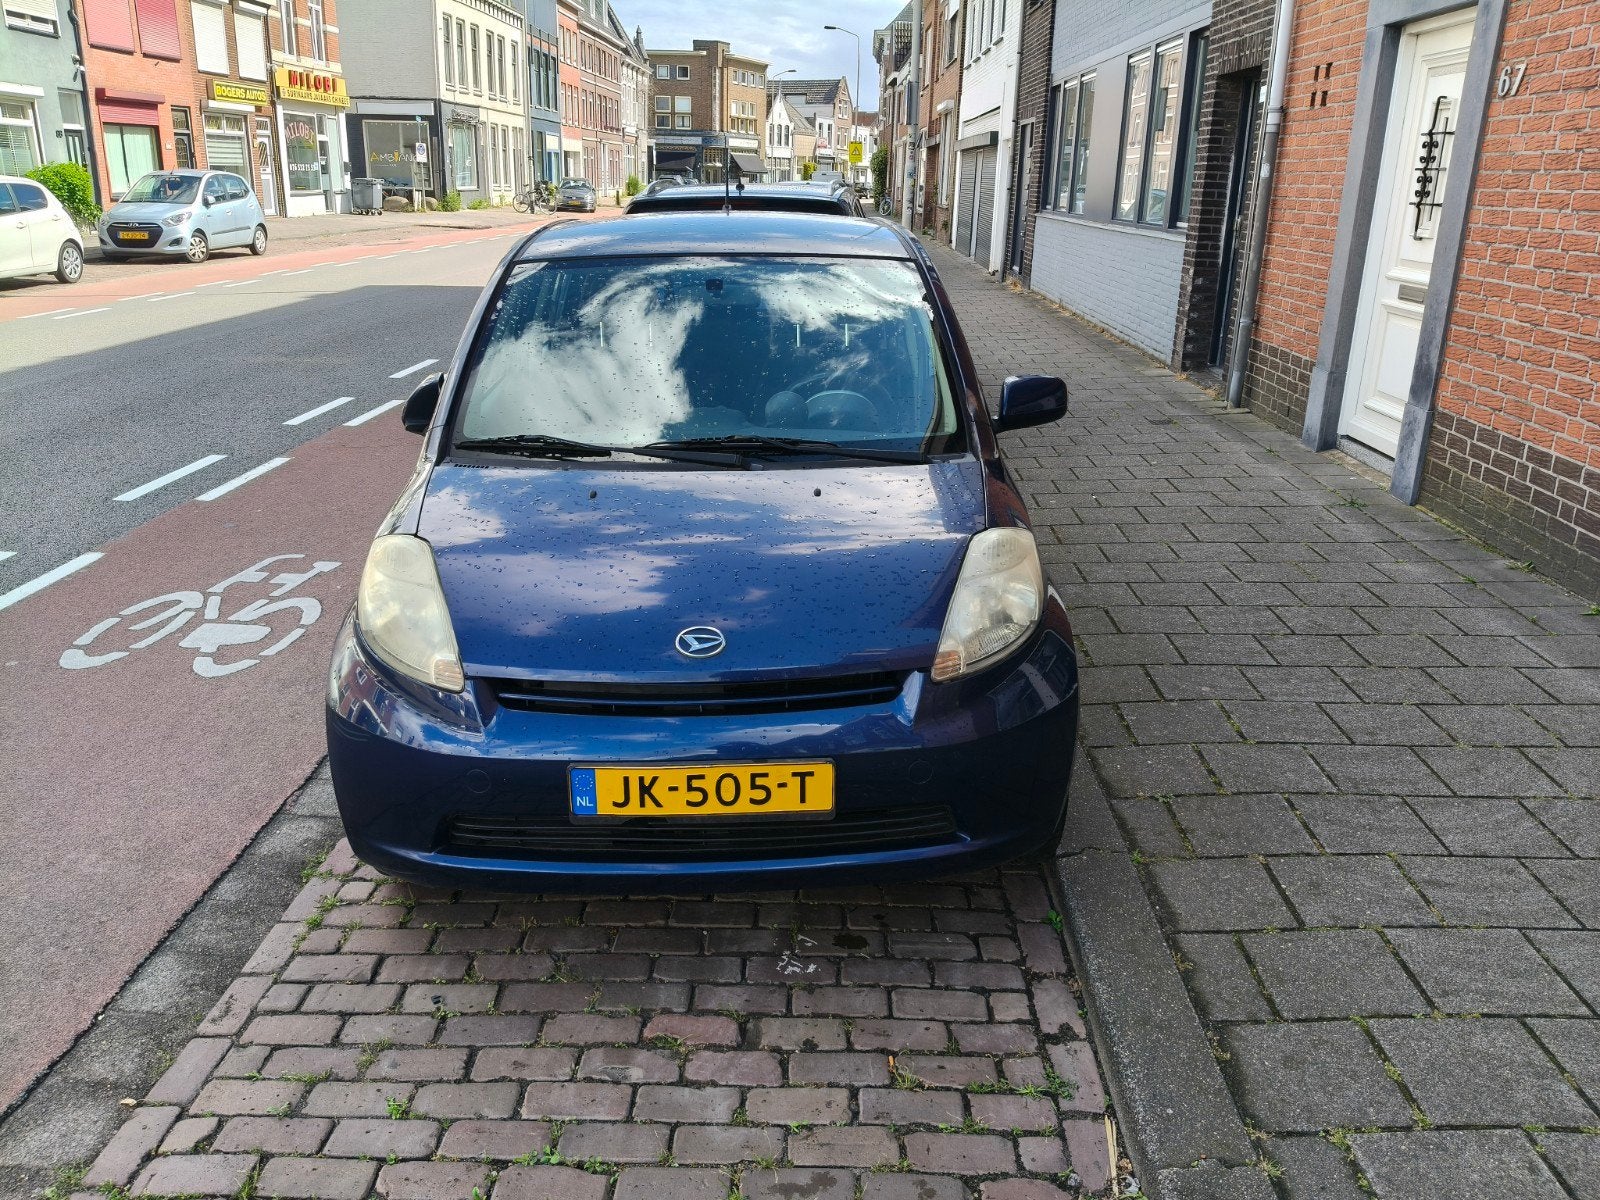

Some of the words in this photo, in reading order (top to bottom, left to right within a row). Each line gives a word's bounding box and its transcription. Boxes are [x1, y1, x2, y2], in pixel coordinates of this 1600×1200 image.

[289, 70, 337, 94] MILOBI
[1498, 60, 1527, 96] 67
[216, 86, 245, 98] BOGERS
[246, 90, 266, 101] AUTOS
[285, 121, 314, 145] MILOBI
[370, 150, 417, 162] AMBIANC
[576, 796, 594, 807] NL
[612, 771, 815, 808] JK-505-T
